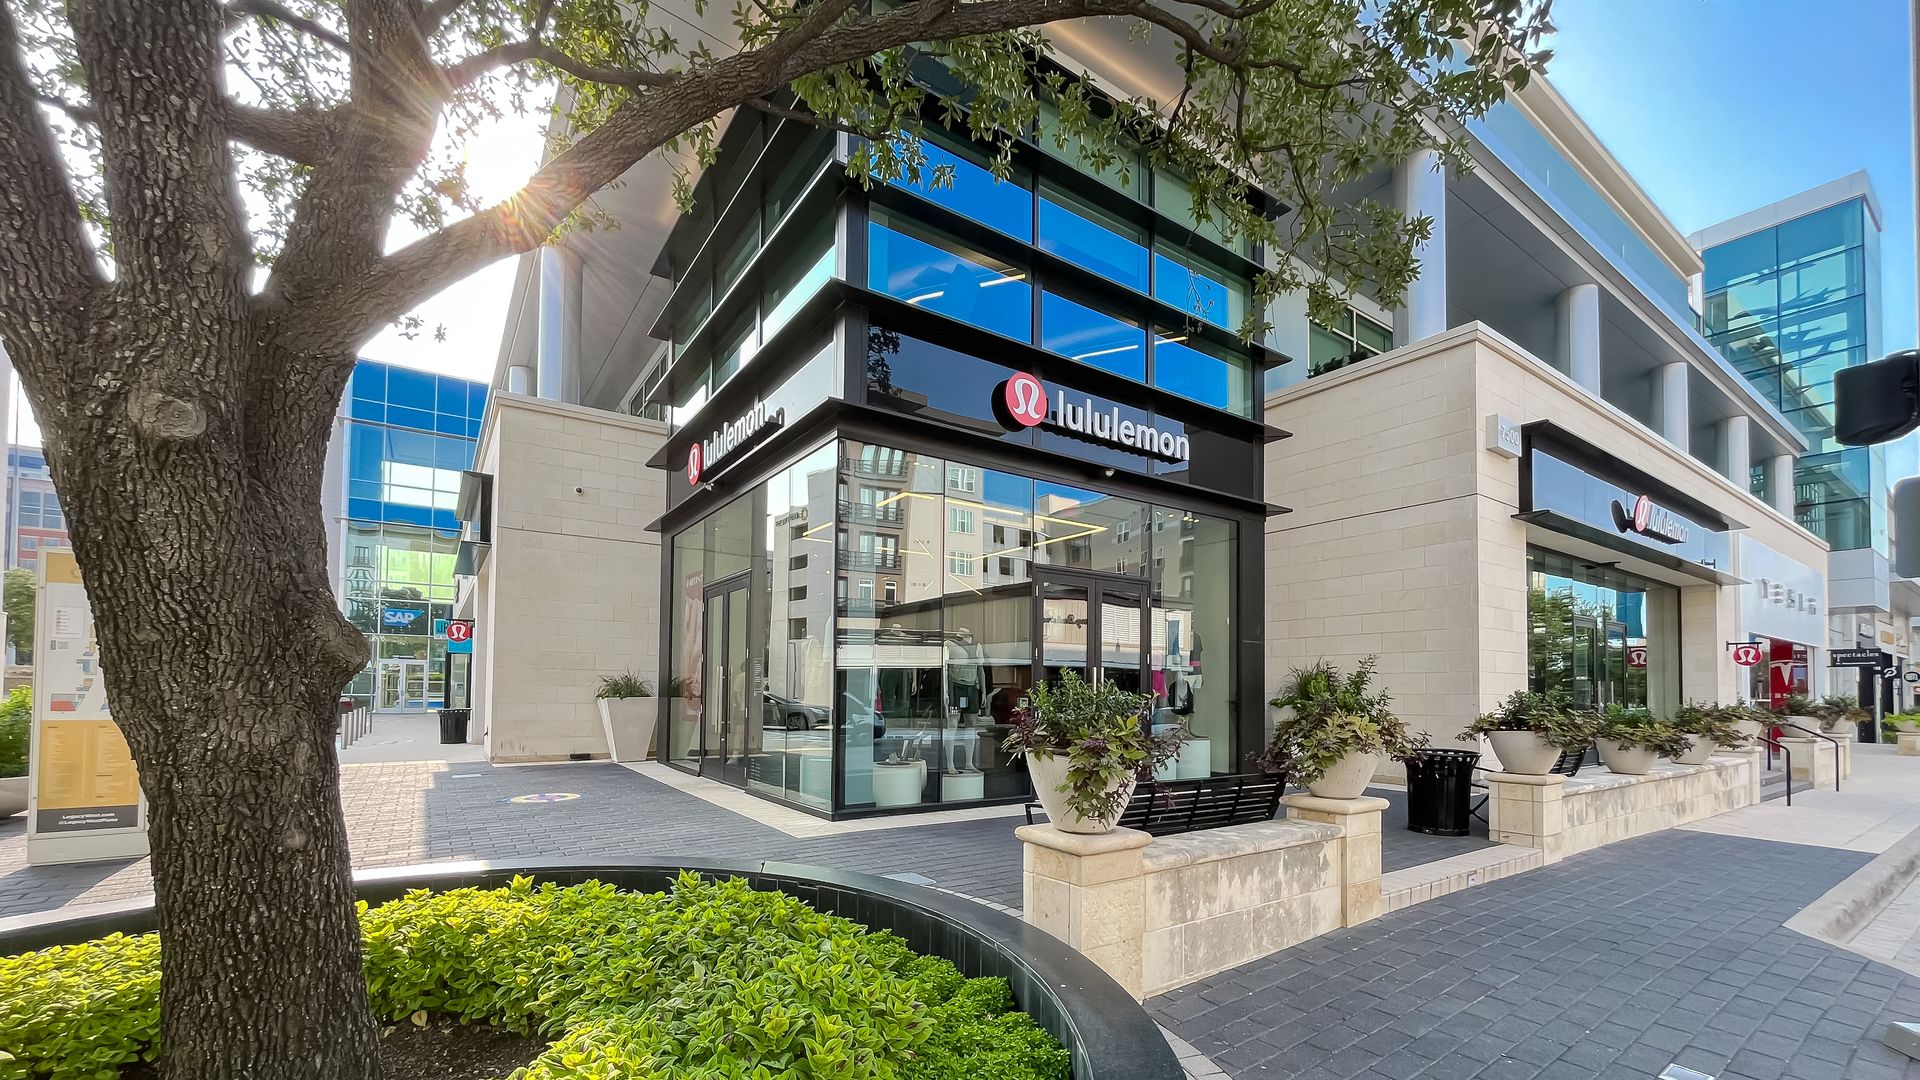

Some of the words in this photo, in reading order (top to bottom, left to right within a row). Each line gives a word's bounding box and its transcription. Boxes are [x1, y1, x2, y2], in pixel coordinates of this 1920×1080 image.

[703, 401, 766, 470] lululemon
[1057, 390, 1190, 461] lululemon
[1500, 424, 1520, 446] 7500
[1647, 504, 1689, 543] lululemon
[1756, 578, 1817, 615] TESLA
[384, 611, 415, 624] SAP
[1832, 650, 1880, 662] spectacles
